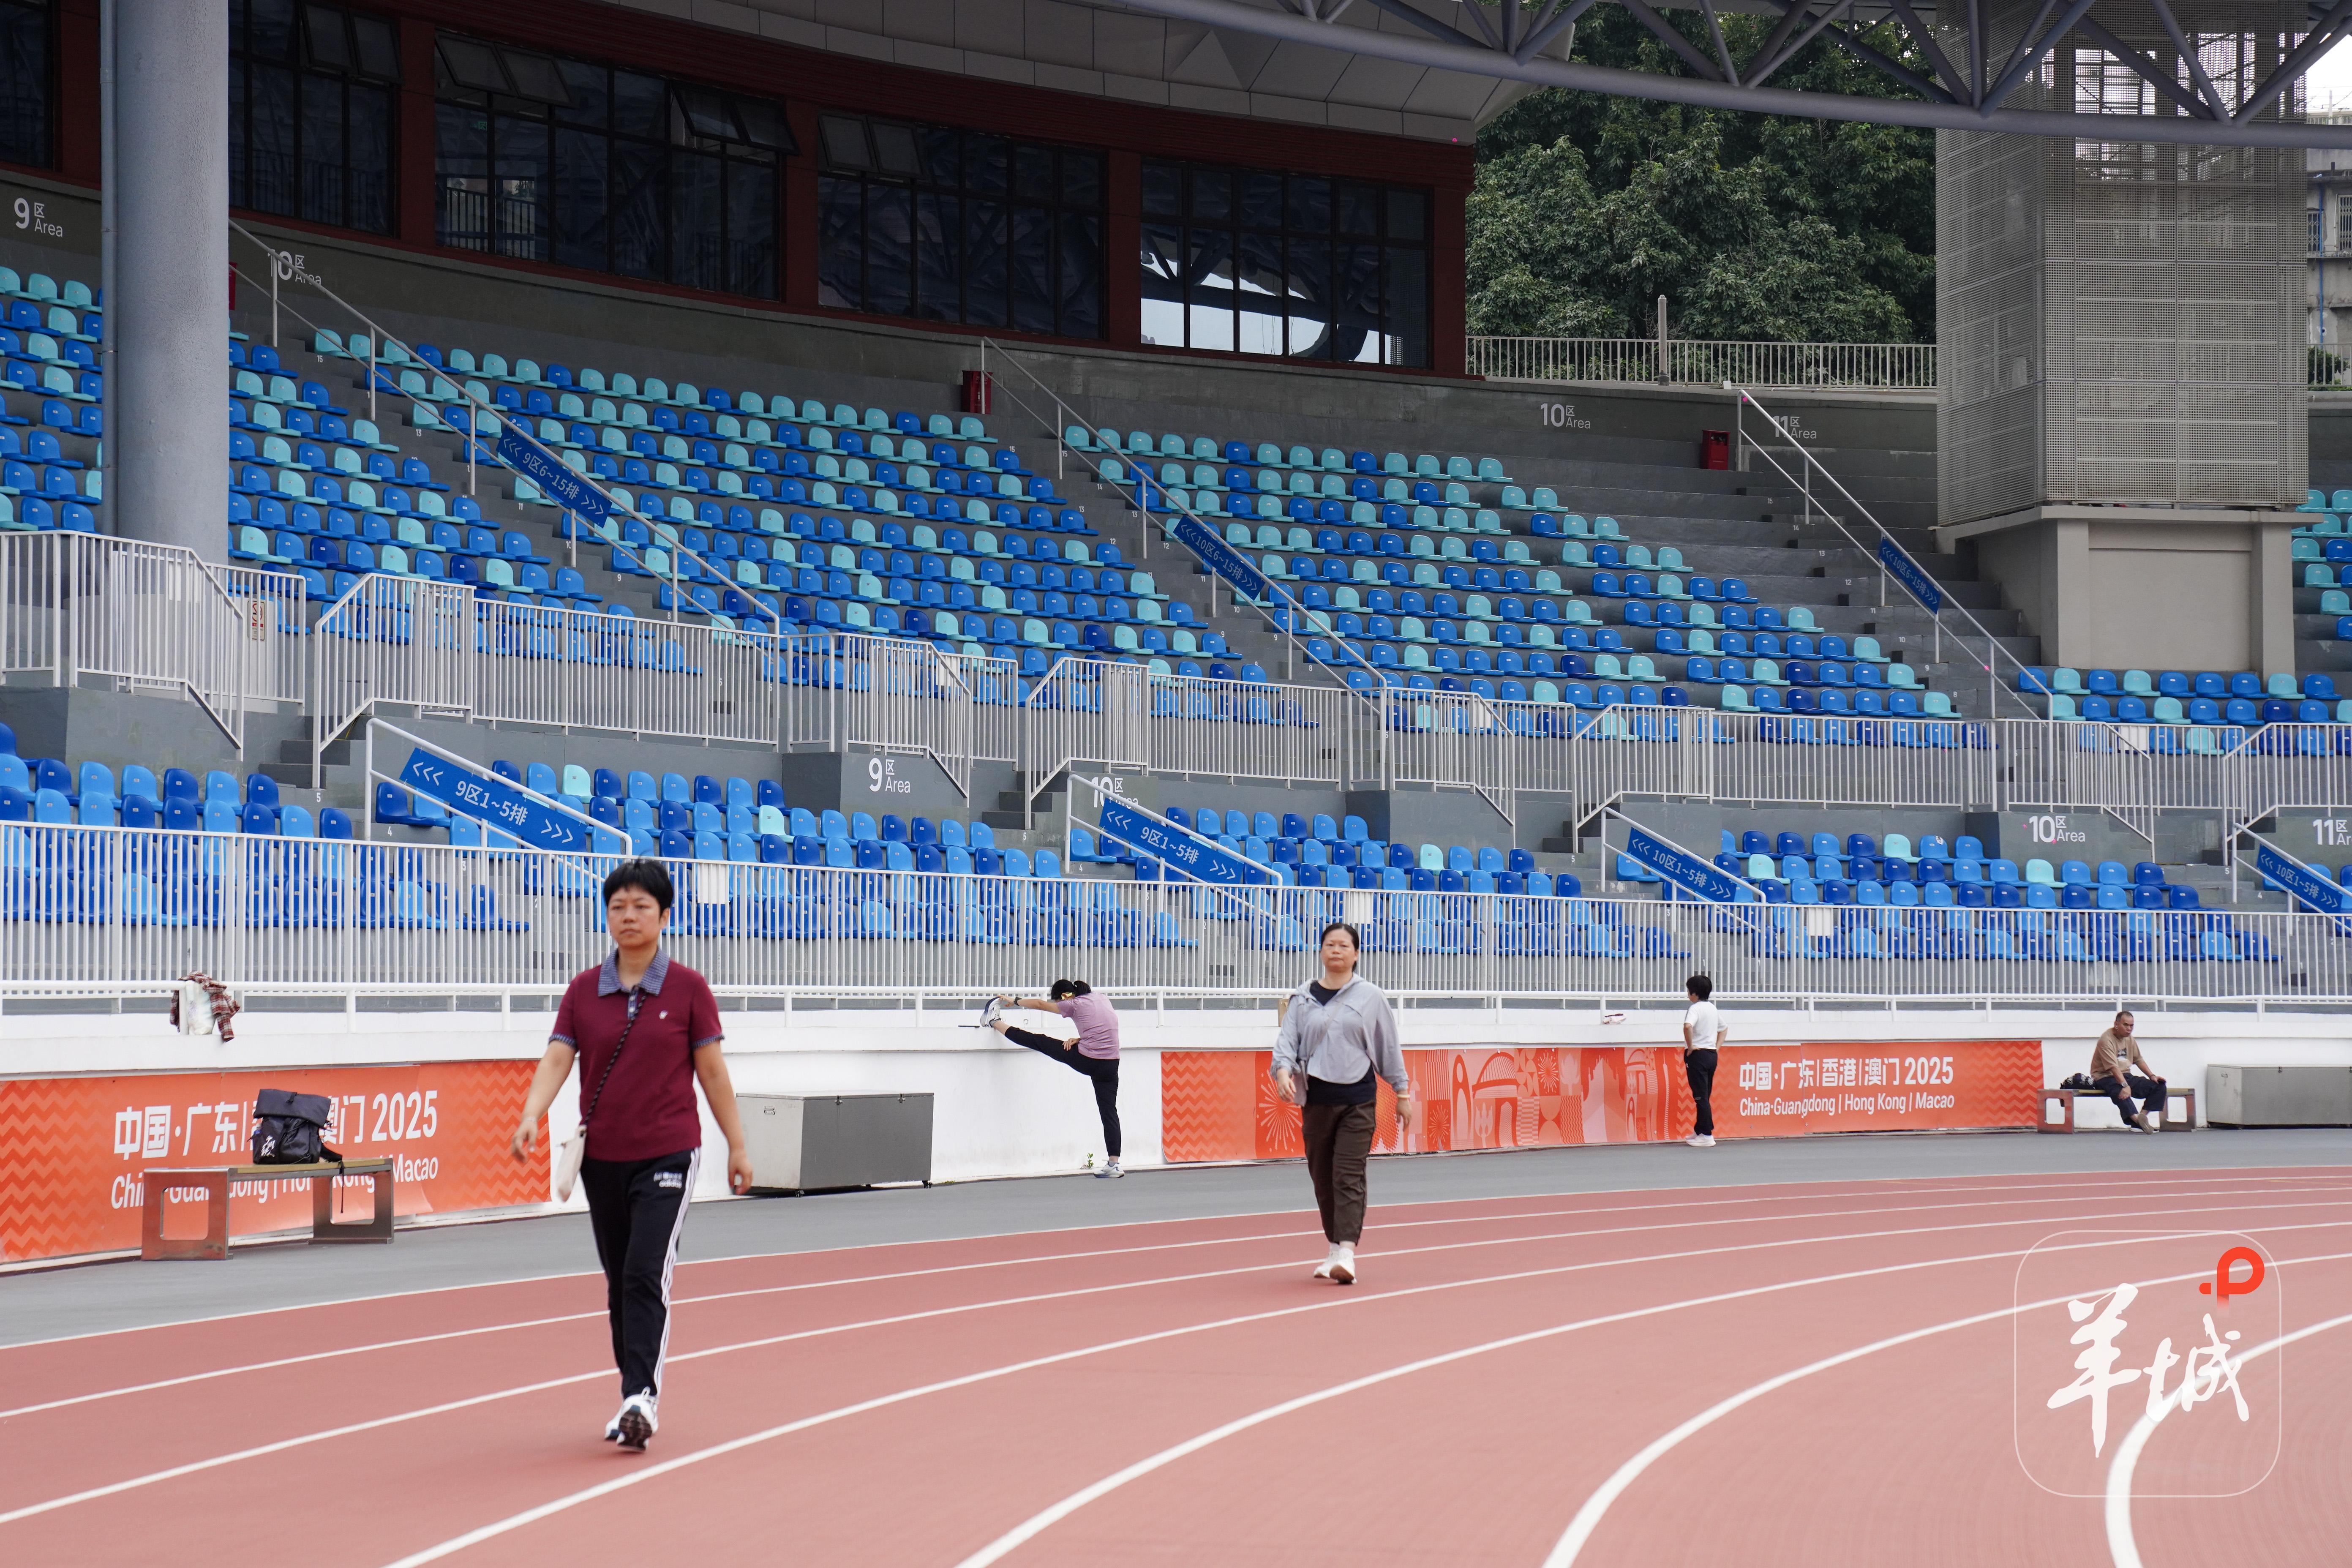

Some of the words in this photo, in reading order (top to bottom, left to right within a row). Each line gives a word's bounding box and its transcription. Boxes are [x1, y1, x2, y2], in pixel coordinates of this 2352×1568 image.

[35, 219, 63, 238] Area
[1566, 417, 1590, 429] Area
[1791, 428, 1816, 439] Area
[886, 777, 910, 793] Area
[317, 793, 321, 802] 5
[456, 781, 528, 825] 9区1~5排
[387, 826, 392, 836] 4
[2057, 829, 2085, 843] Area
[1141, 827, 1198, 864] 9区1~5排
[462, 861, 466, 871] 3
[1652, 850, 1707, 886] 10区1~5排
[1905, 1057, 1954, 1085] 2025
[1845, 1094, 1874, 1115] Hong
[1878, 1093, 1906, 1114] Kong
[1915, 1092, 1954, 1109] Macao
[371, 1090, 437, 1141] 2025
